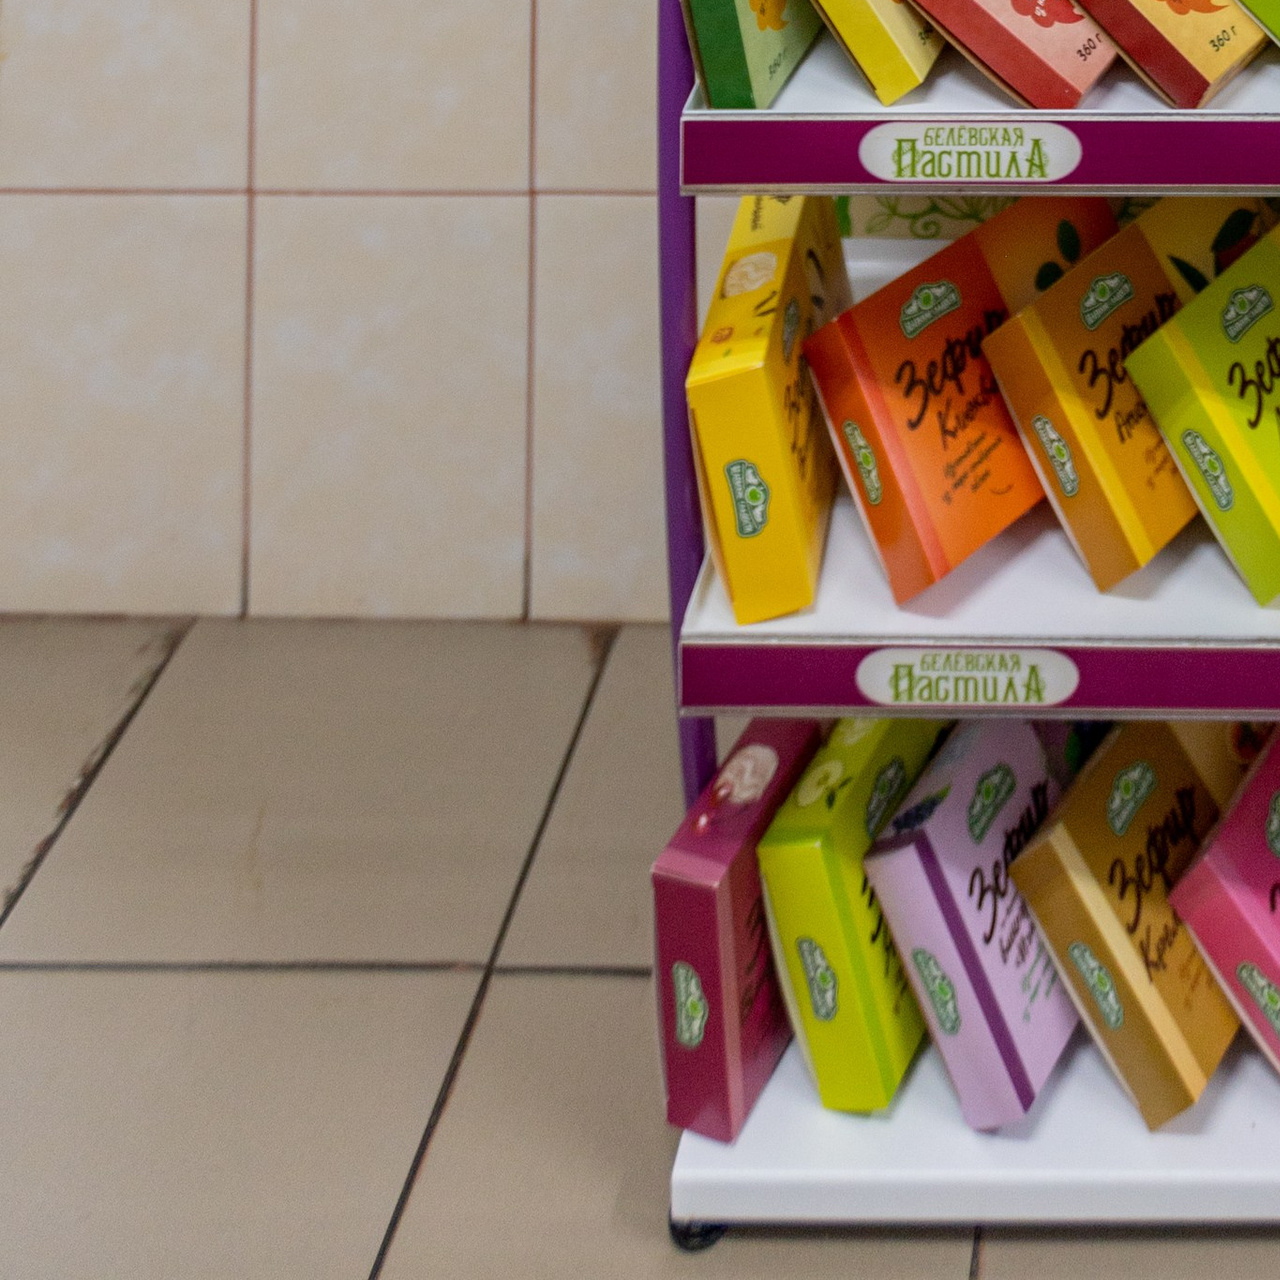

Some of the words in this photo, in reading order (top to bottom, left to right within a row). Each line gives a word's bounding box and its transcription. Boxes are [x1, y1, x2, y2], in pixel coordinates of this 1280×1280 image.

[1076, 37, 1097, 62] 360
[1208, 30, 1231, 53] 360
[923, 124, 1024, 148] БЕЛЁВСКАЯ
[920, 651, 1022, 673] БЕЛЁВСКАЯ
